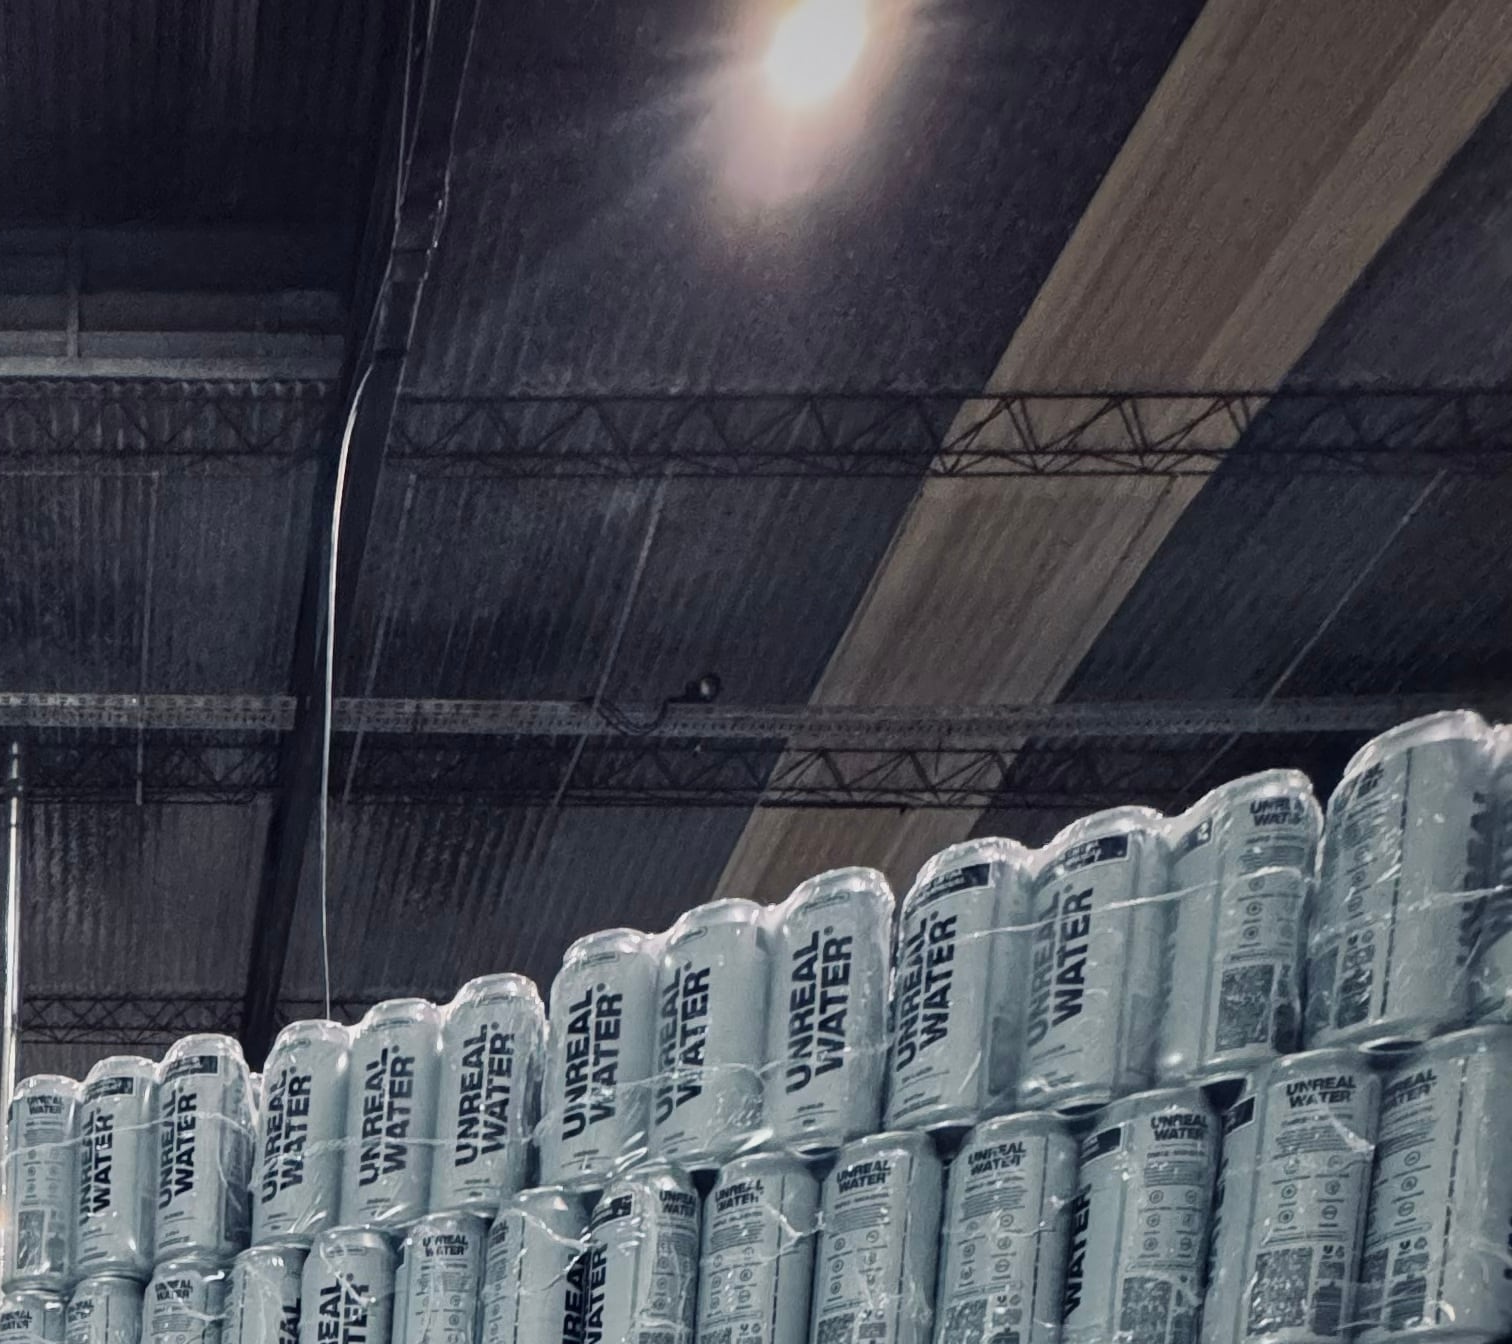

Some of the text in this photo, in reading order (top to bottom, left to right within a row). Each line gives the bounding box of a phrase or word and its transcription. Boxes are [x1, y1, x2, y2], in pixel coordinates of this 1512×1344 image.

[786, 931, 821, 1094] UNREAL
[815, 936, 854, 1078] WATER
[897, 917, 928, 1073] UNREAL
[919, 914, 958, 1052] WATER
[1052, 887, 1094, 1028] WATER
[455, 1024, 488, 1167] UNREAL
[481, 1033, 515, 1154] WATER
[563, 983, 593, 1141] UNREAL
[588, 993, 623, 1125] WATER
[675, 967, 711, 1109] WATER
[1287, 1075, 1356, 1096] UNREAL
[1289, 1089, 1354, 1108] WATER
[93, 1113, 113, 1213] WATER
[174, 1093, 196, 1195] WATER
[262, 1071, 287, 1202] UNREAL
[281, 1075, 311, 1189] WATER
[359, 1049, 388, 1186] UNREAL
[382, 1056, 415, 1175] WATER
[836, 1159, 892, 1182] UNREAL
[1150, 1112, 1208, 1130] UNREAL
[1154, 1124, 1206, 1143] WATER
[837, 1173, 890, 1194] WATER
